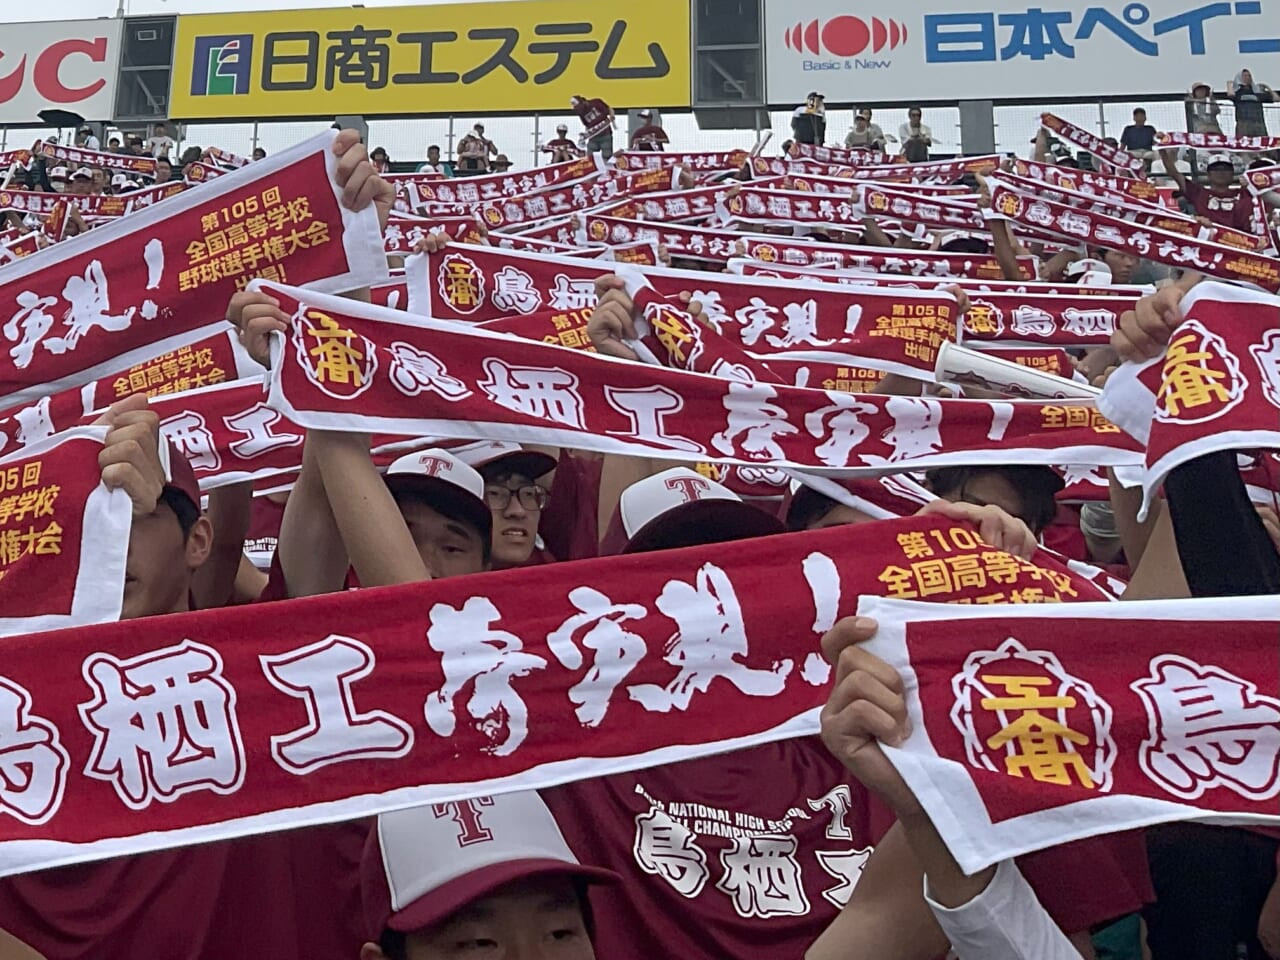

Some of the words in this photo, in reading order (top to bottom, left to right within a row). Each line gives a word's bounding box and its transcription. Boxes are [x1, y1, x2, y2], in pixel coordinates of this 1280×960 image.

[261, 19, 671, 91] 日商エステム
[802, 59, 841, 71] Basic
[843, 61, 852, 70] &
[854, 58, 892, 70] New
[185, 196, 313, 266] 全国高等学校
[200, 186, 282, 233] 第105回
[178, 220, 331, 291] 野球選手権大会
[892, 303, 950, 317] 第105回
[418, 454, 453, 477] T
[664, 474, 712, 504] T
[433, 796, 495, 848] T
[669, 801, 732, 824] NATIONAL
[735, 813, 764, 830] HIGH
[807, 784, 853, 841] T
